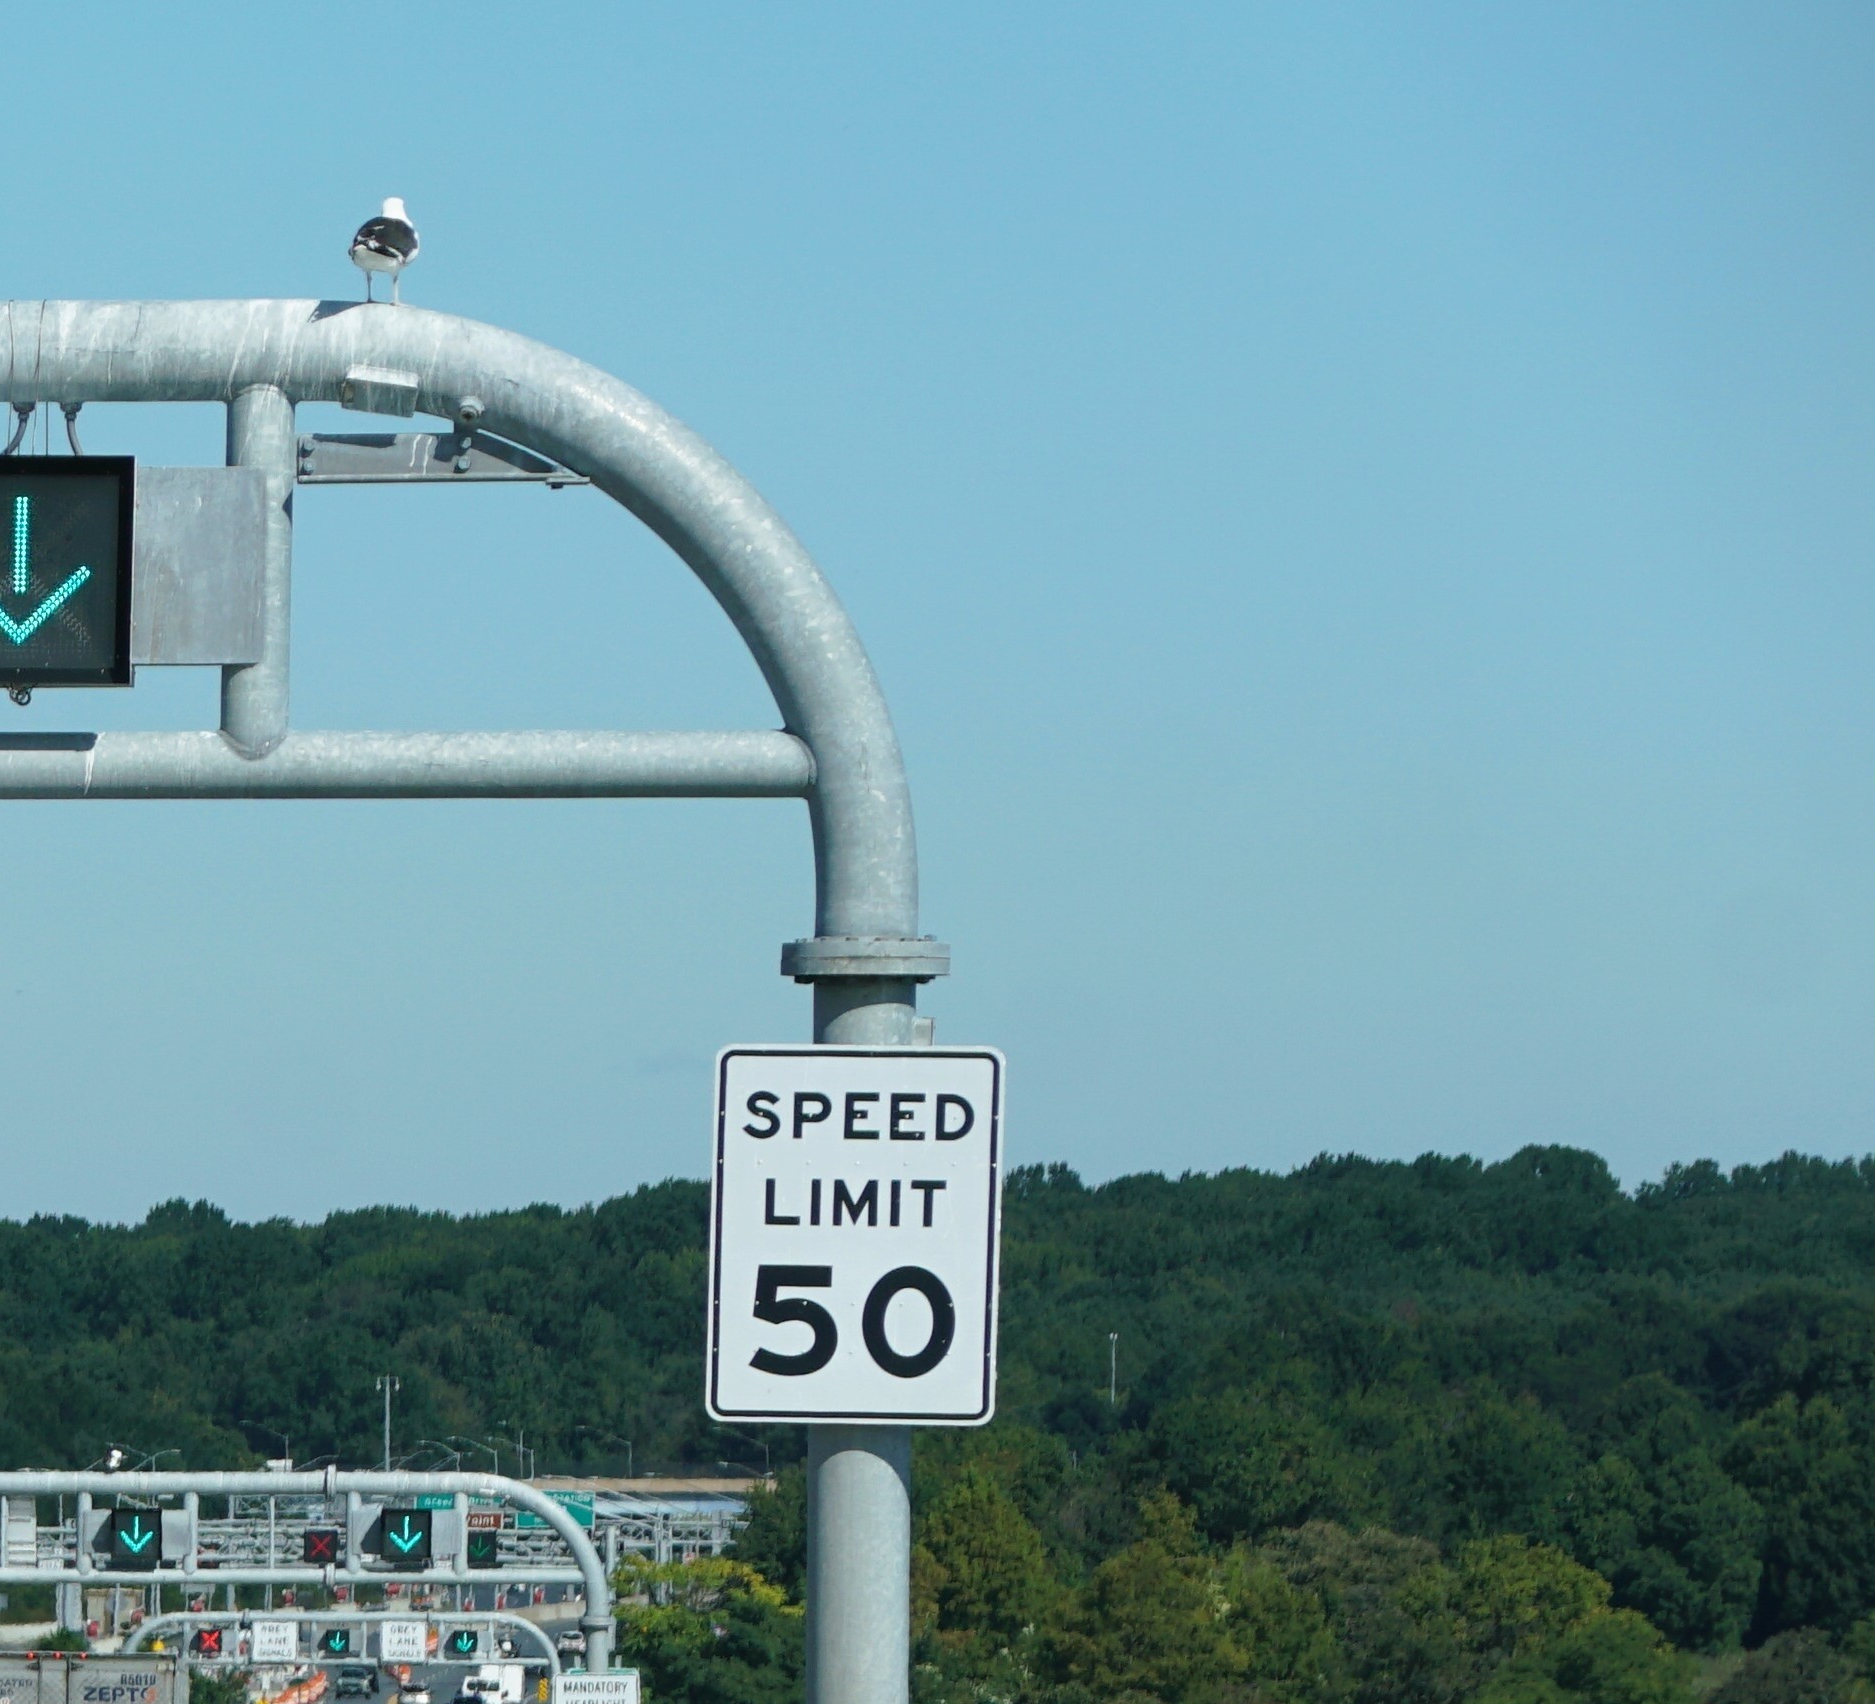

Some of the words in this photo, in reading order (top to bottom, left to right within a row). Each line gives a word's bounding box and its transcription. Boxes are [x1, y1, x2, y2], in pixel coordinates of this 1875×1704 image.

[742, 1090, 975, 1141] SPEED
[764, 1178, 948, 1228] LIMIT
[748, 1264, 956, 1379] 50
[563, 1681, 628, 1694] MANDATORY
